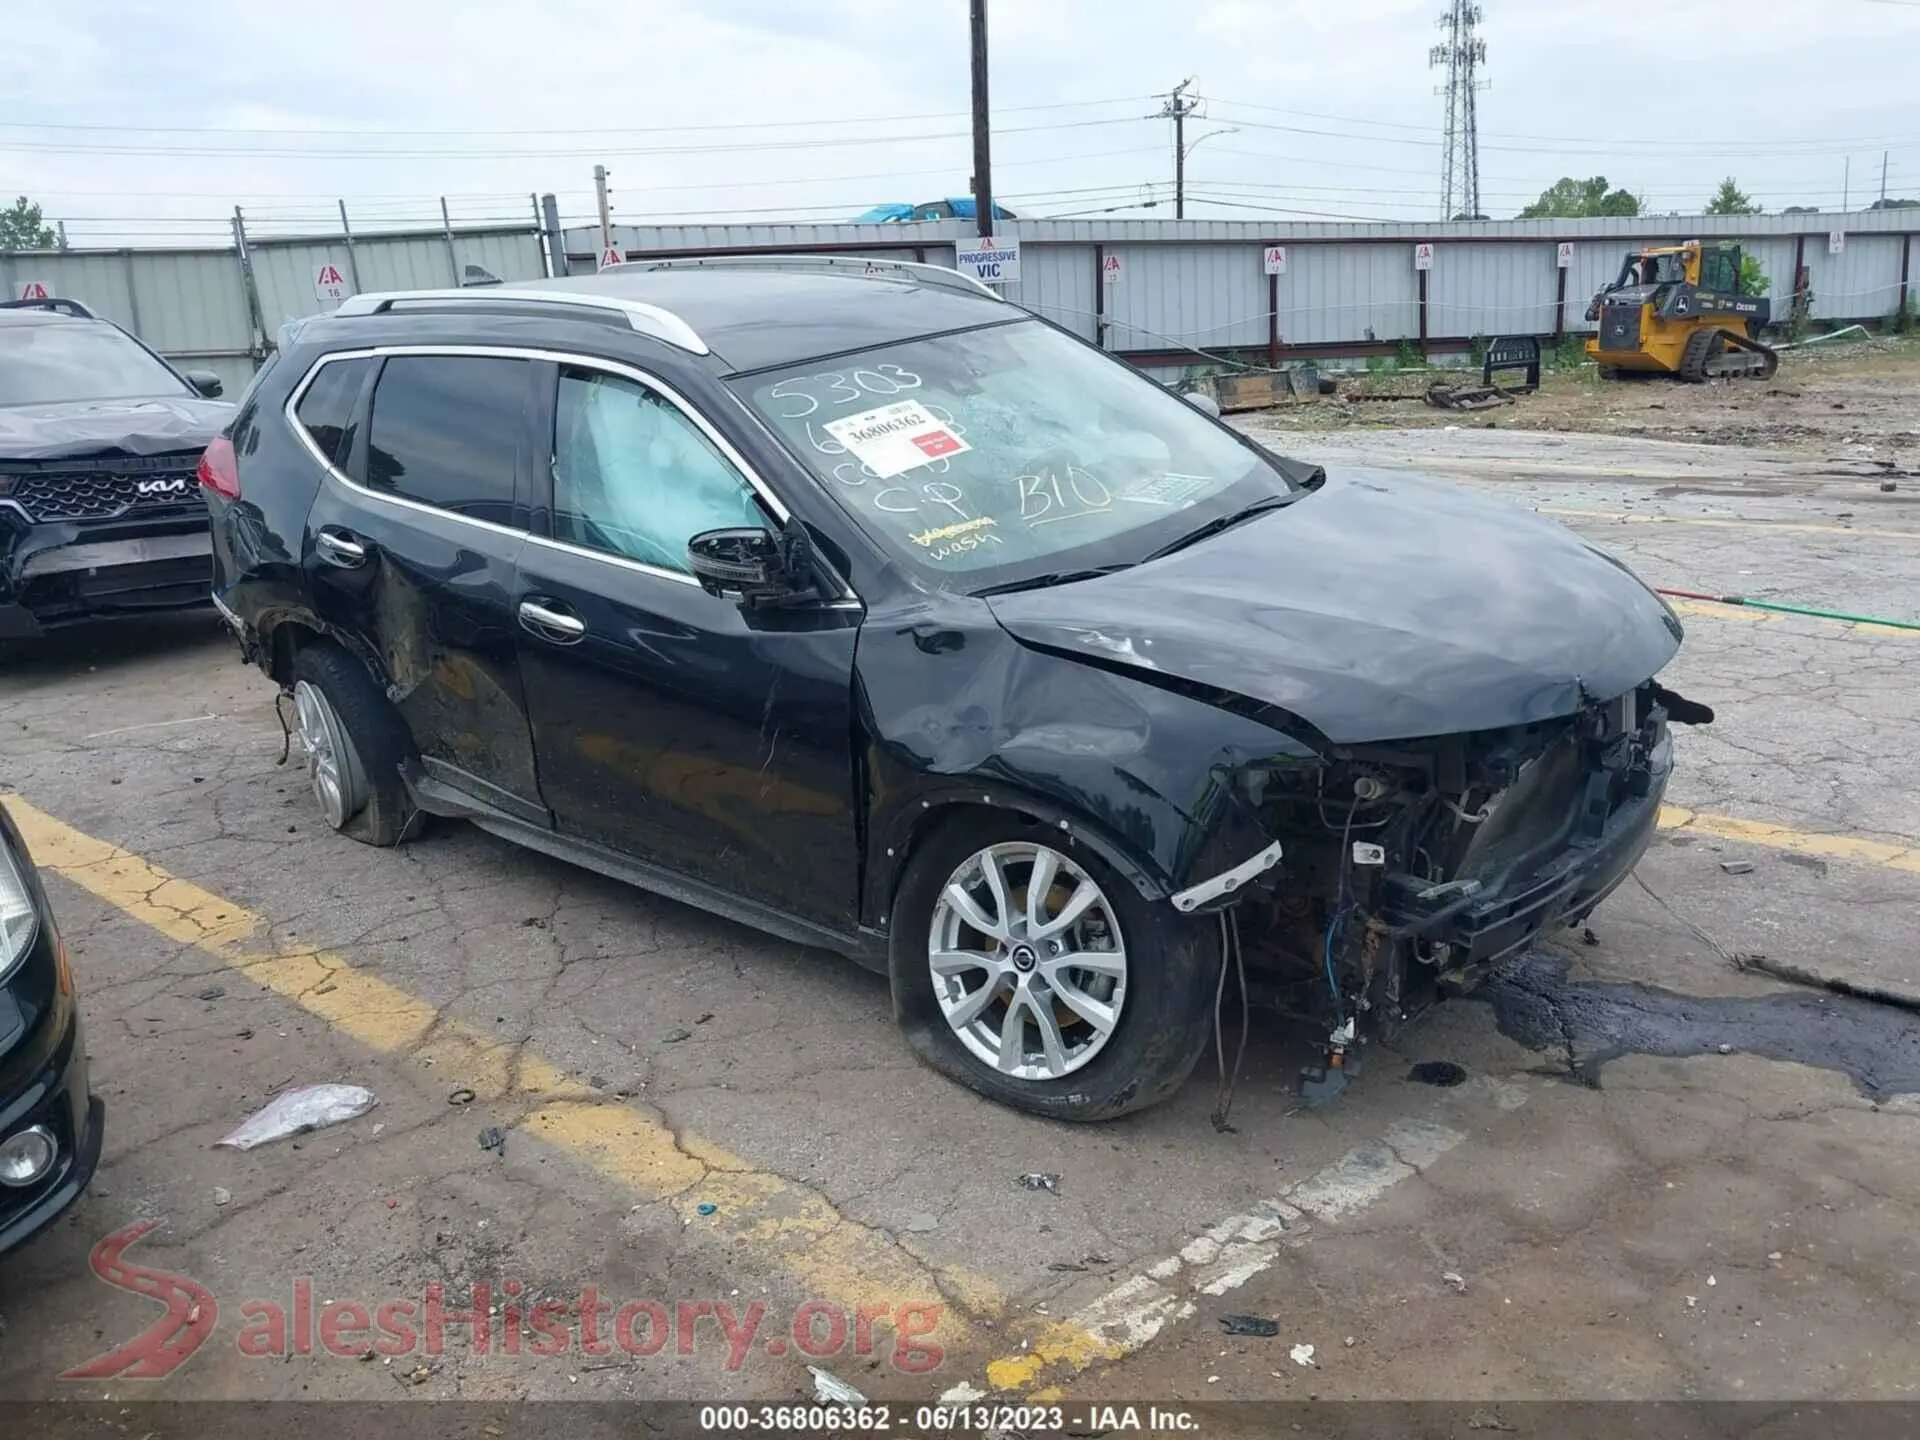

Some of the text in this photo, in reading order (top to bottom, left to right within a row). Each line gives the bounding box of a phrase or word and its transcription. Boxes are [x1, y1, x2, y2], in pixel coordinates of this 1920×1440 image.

[959, 250, 1017, 265] PROGRESSIVE
[977, 263, 1001, 278] VIC
[771, 363, 923, 418] 5303
[847, 412, 927, 444] 36806362
